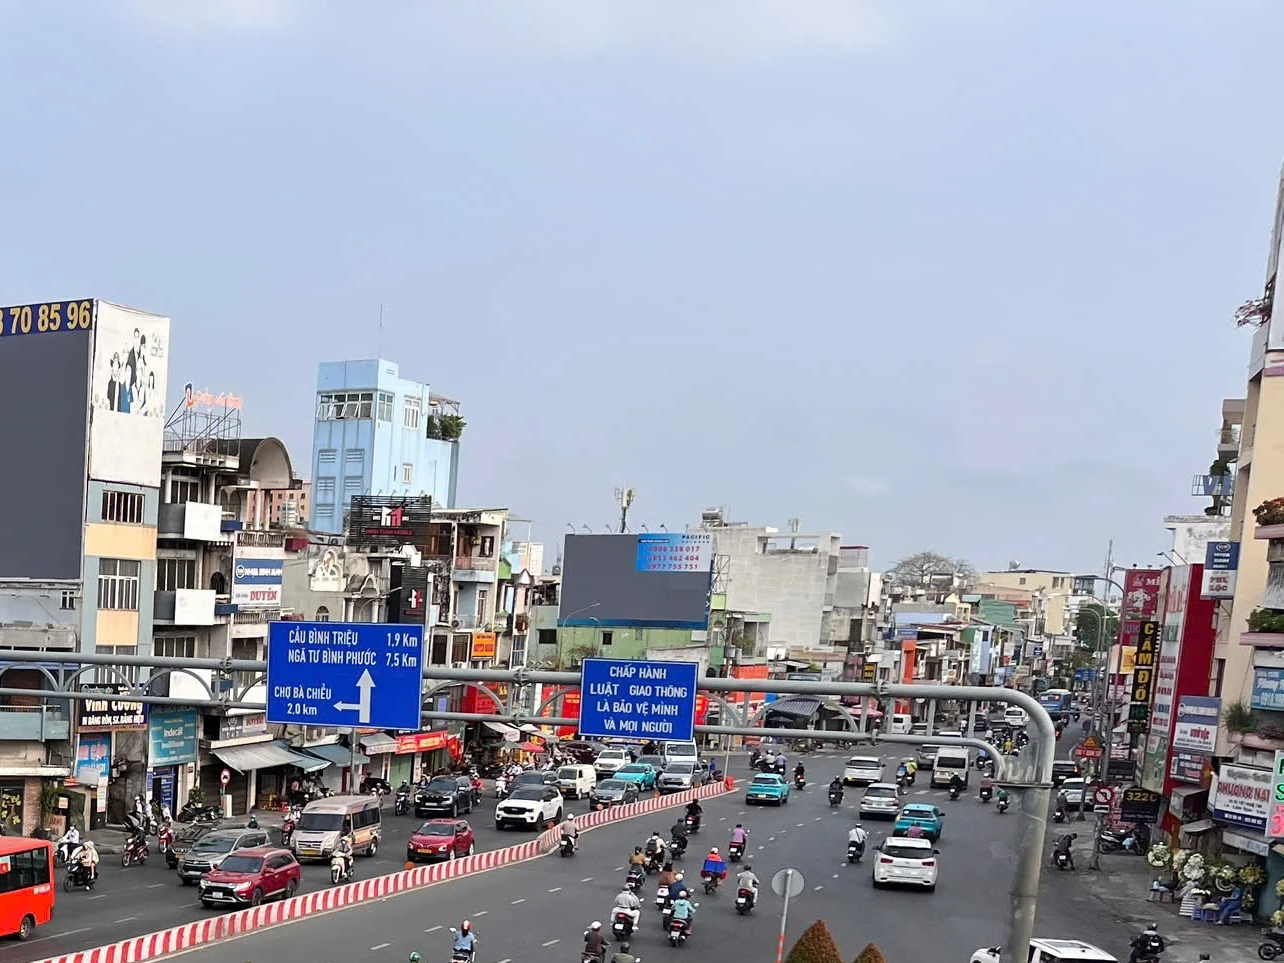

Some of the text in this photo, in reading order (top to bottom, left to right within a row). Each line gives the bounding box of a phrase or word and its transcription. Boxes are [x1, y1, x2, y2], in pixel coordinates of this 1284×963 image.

[10, 306, 32, 334] 70
[37, 303, 61, 331] 85
[67, 300, 91, 330] 96
[288, 626, 306, 644] CẦU
[308, 628, 329, 645] BÌNH
[332, 630, 358, 645] TRIỆU
[403, 633, 417, 647] Km
[288, 647, 306, 663] NGÃ
[308, 649, 319, 663] TƯ
[322, 648, 343, 664] BÌNH
[346, 647, 376, 665] PHƯỚC
[402, 653, 416, 667] Km
[610, 663, 667, 679] CHẤP HÀNH
[274, 683, 332, 700] CHỢ BÀ CHIỂU
[590, 681, 687, 698] LUẬT GIAO THÔNG
[303, 703, 317, 715] km
[597, 698, 678, 716] LÀ BẢO VỆ MÌNH
[604, 717, 673, 733] VÀ MỌI NGƯỜI
